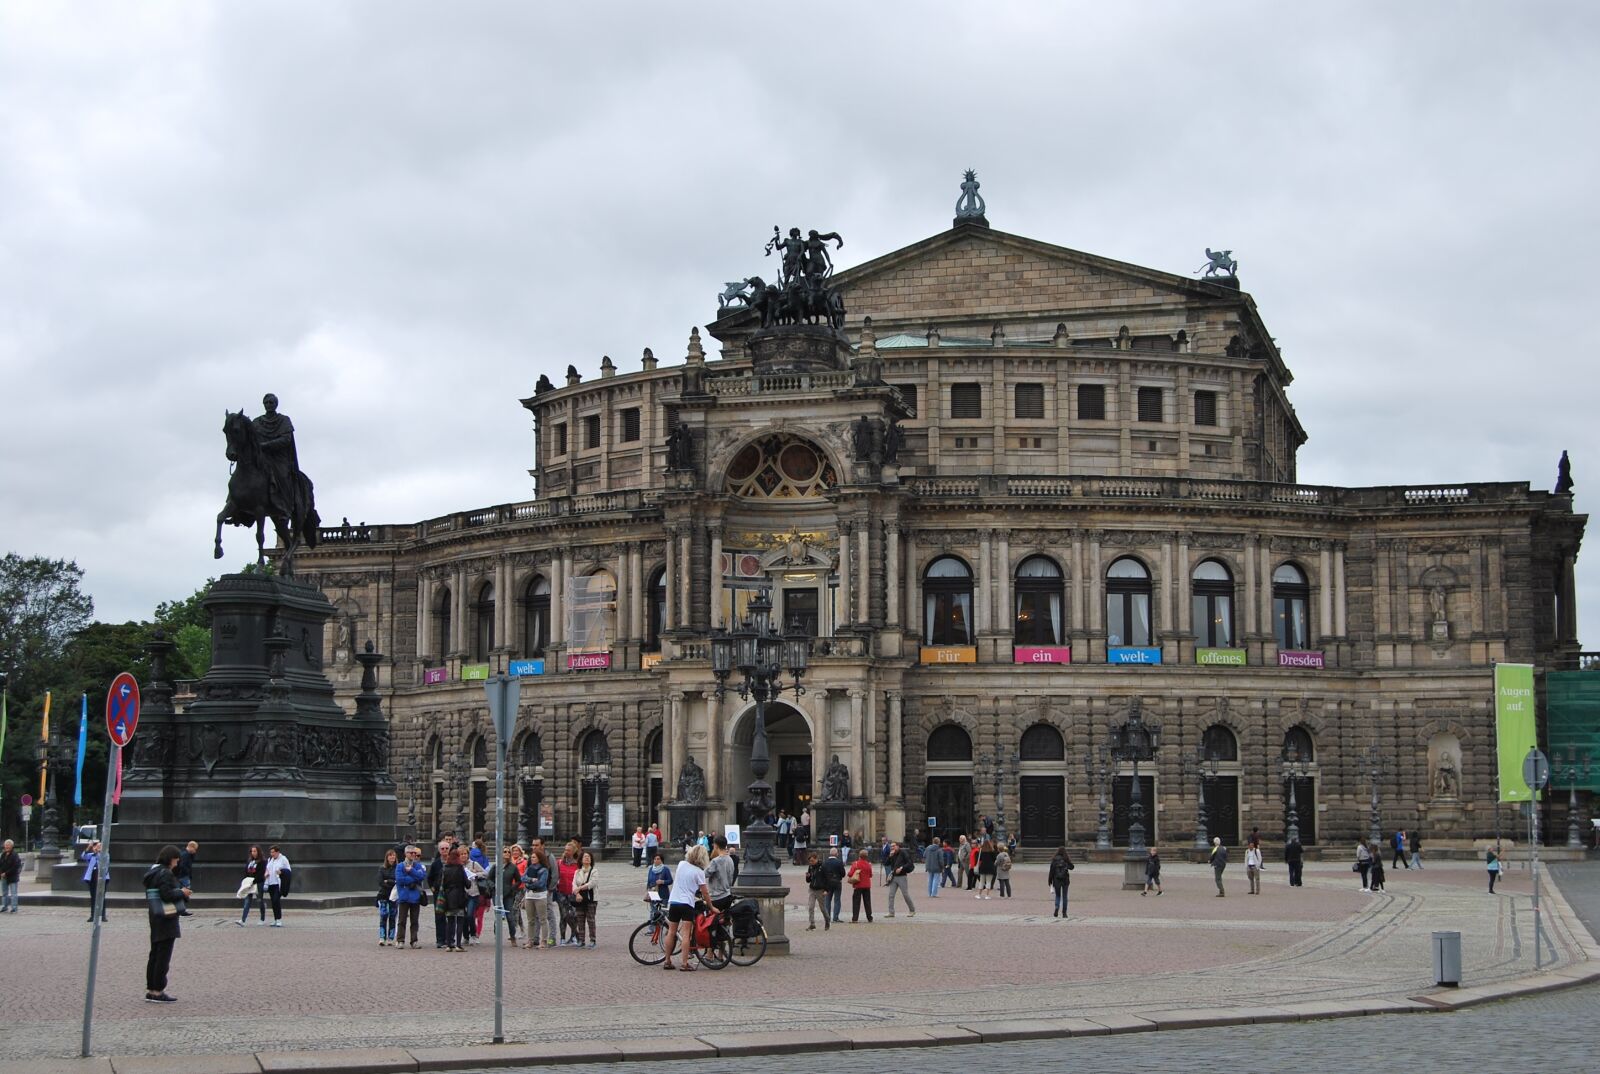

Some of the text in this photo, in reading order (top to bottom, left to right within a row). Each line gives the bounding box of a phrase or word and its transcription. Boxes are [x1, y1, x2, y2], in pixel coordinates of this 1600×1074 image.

[937, 650, 1323, 666] Für ein welt- offenes Dresden
[431, 671, 440, 682] Für
[469, 670, 480, 679] ein
[517, 663, 536, 673] welt-
[1500, 686, 1530, 698] Augen
[1506, 701, 1524, 711] auf.
